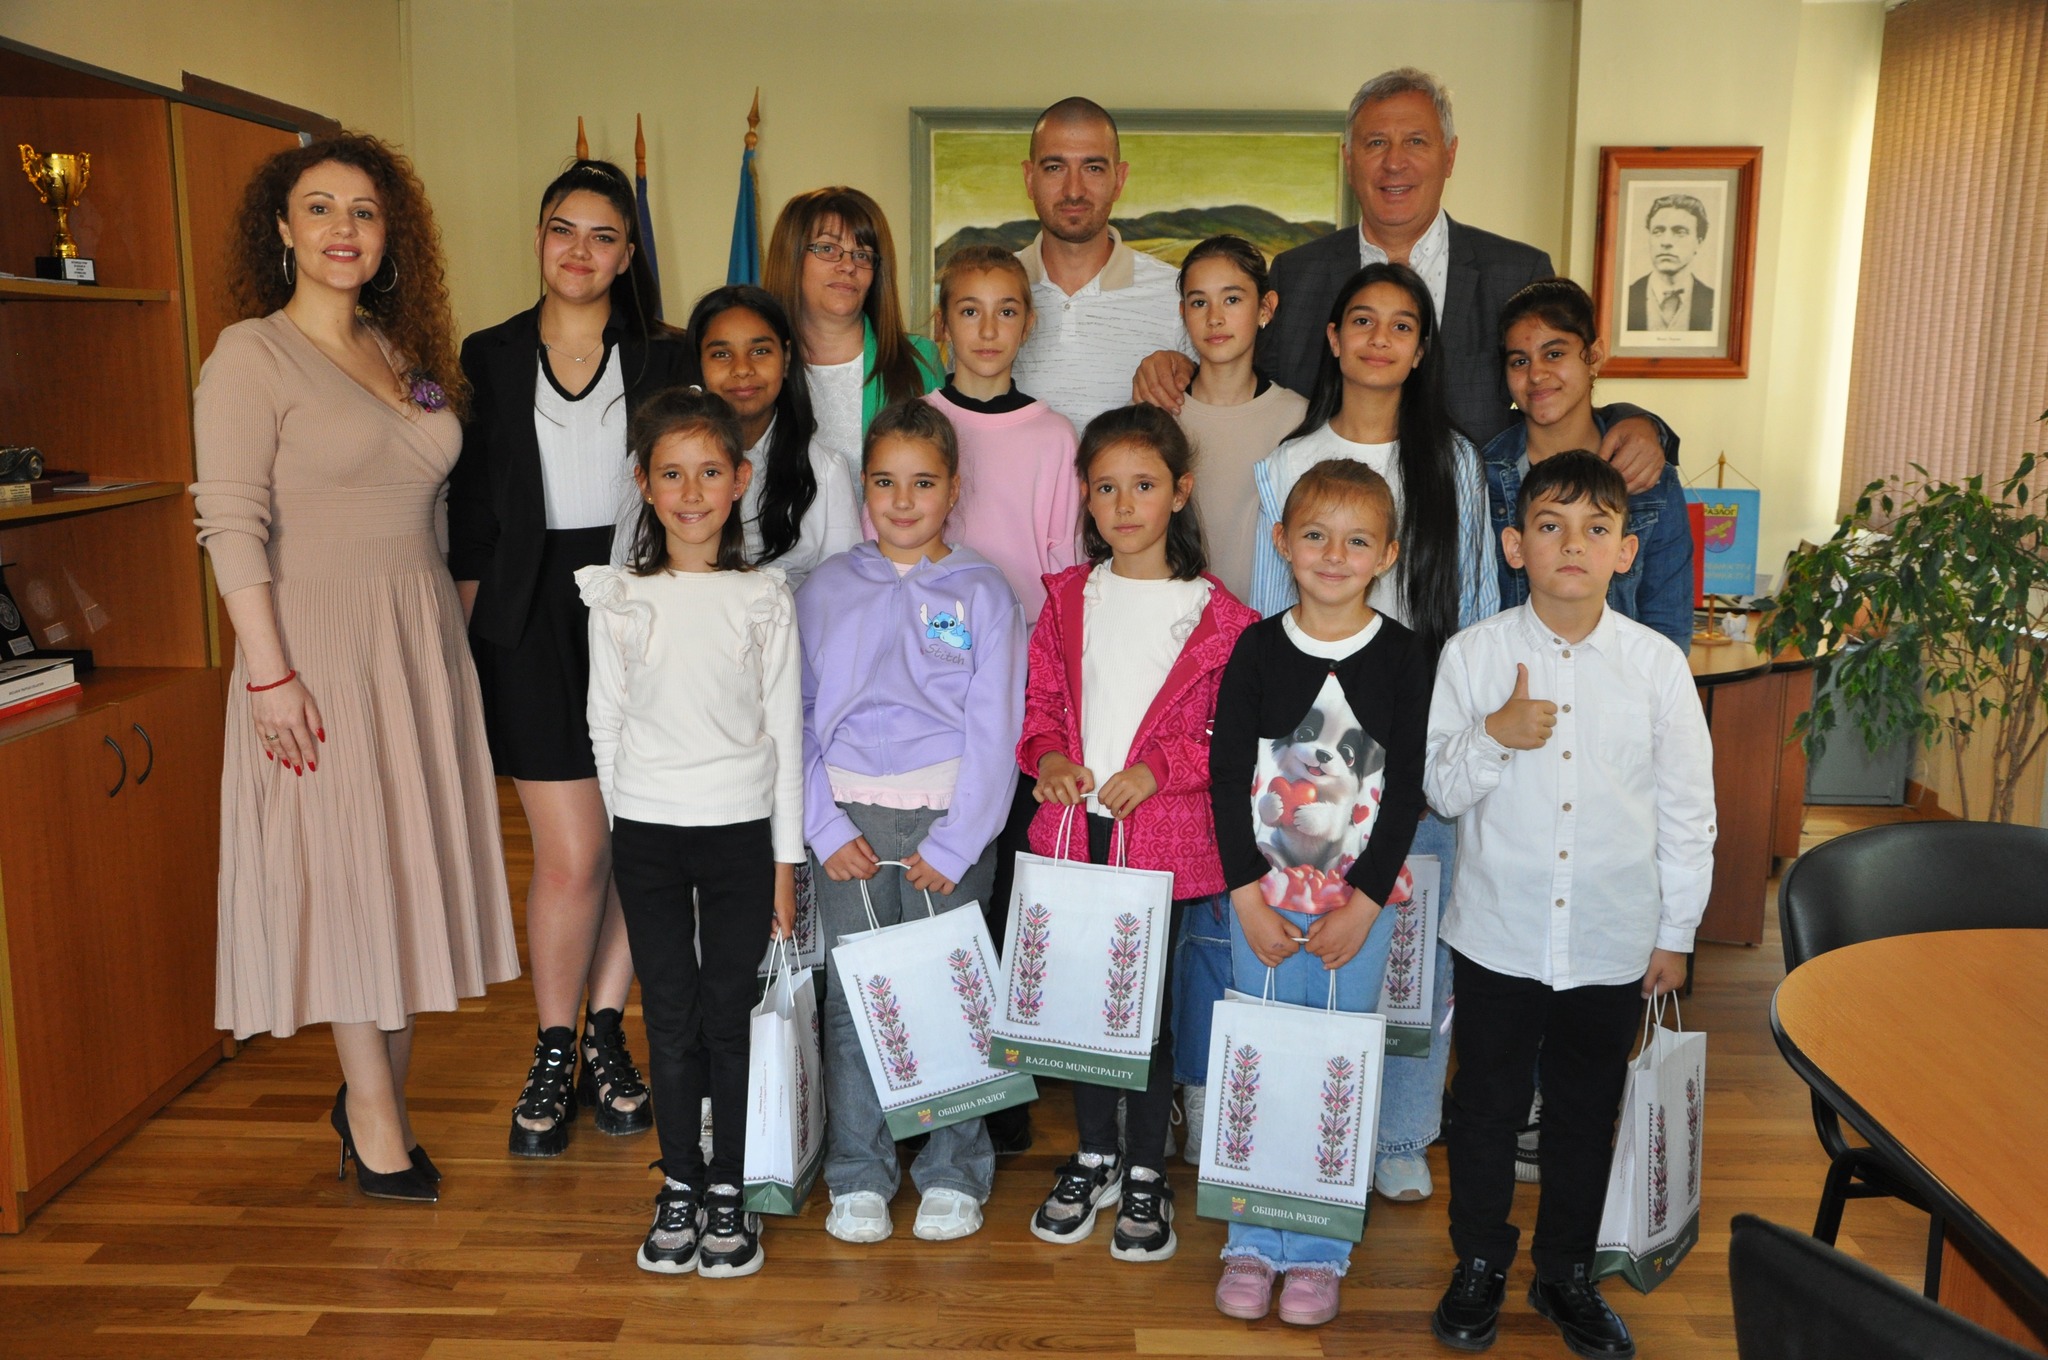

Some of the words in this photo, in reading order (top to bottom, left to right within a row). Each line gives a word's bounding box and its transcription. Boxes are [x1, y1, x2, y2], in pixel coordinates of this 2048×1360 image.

[925, 643, 965, 665] Stitch
[1025, 1055, 1064, 1069] RAZLOG
[1066, 1062, 1134, 1080] MUNICIPALITY
[937, 1100, 977, 1118] ОБЩИНА
[976, 1090, 1007, 1107] РАЗЛОГ
[1252, 1204, 1294, 1220] ОБЩИНА
[1296, 1212, 1331, 1226] РАЗЛОГ
